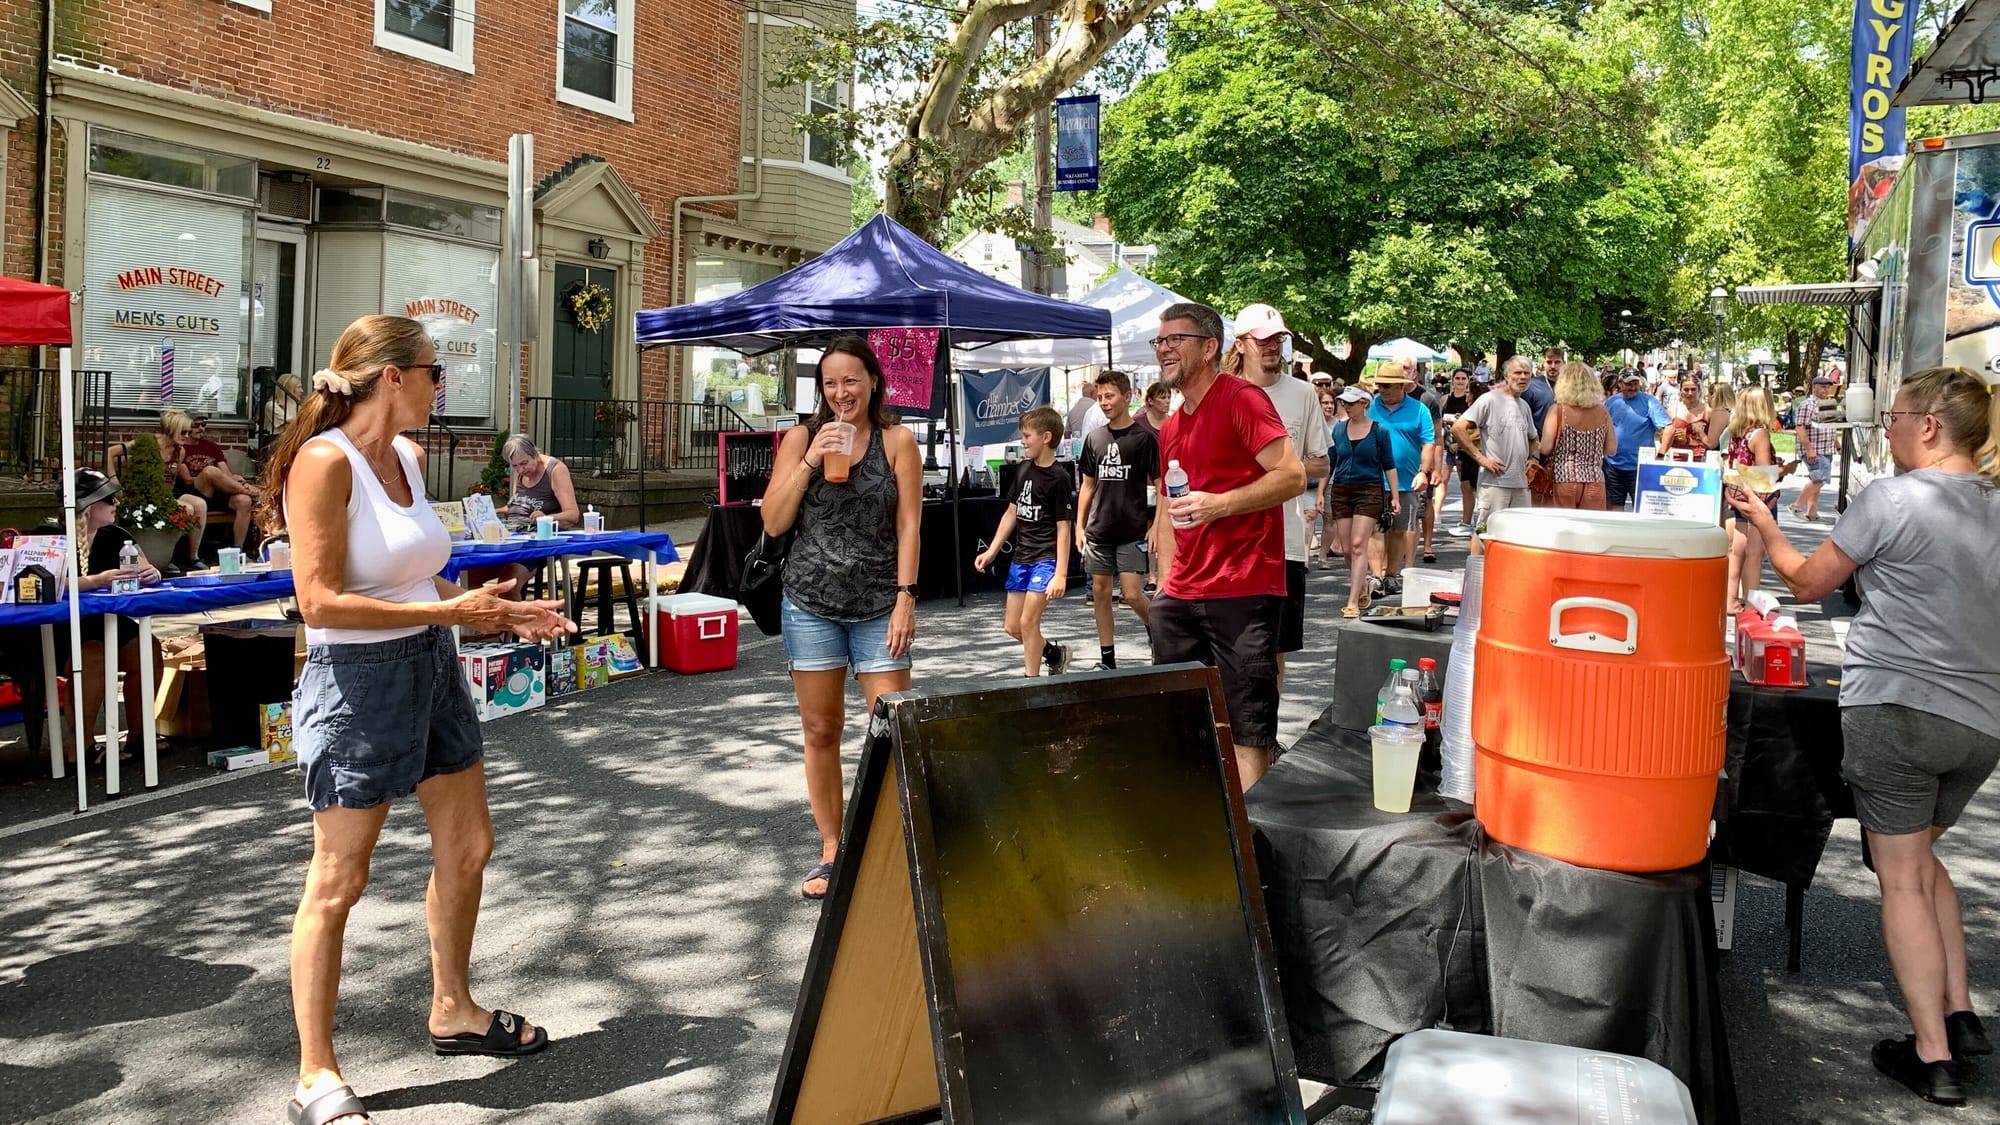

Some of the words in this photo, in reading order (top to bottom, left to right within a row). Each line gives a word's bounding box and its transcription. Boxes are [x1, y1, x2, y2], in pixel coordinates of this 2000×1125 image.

[1861, 0, 1905, 153] GYROS
[316, 157, 331, 170] 22
[117, 267, 163, 290] MAIN
[168, 267, 225, 298] STREET
[115, 309, 165, 327] MEN'S
[176, 315, 220, 331] CUTS
[405, 299, 436, 318] MAIN
[439, 299, 480, 325] STREET
[447, 340, 478, 354] CUTS
[887, 334, 915, 360] $5
[976, 395, 1020, 419] Chamber
